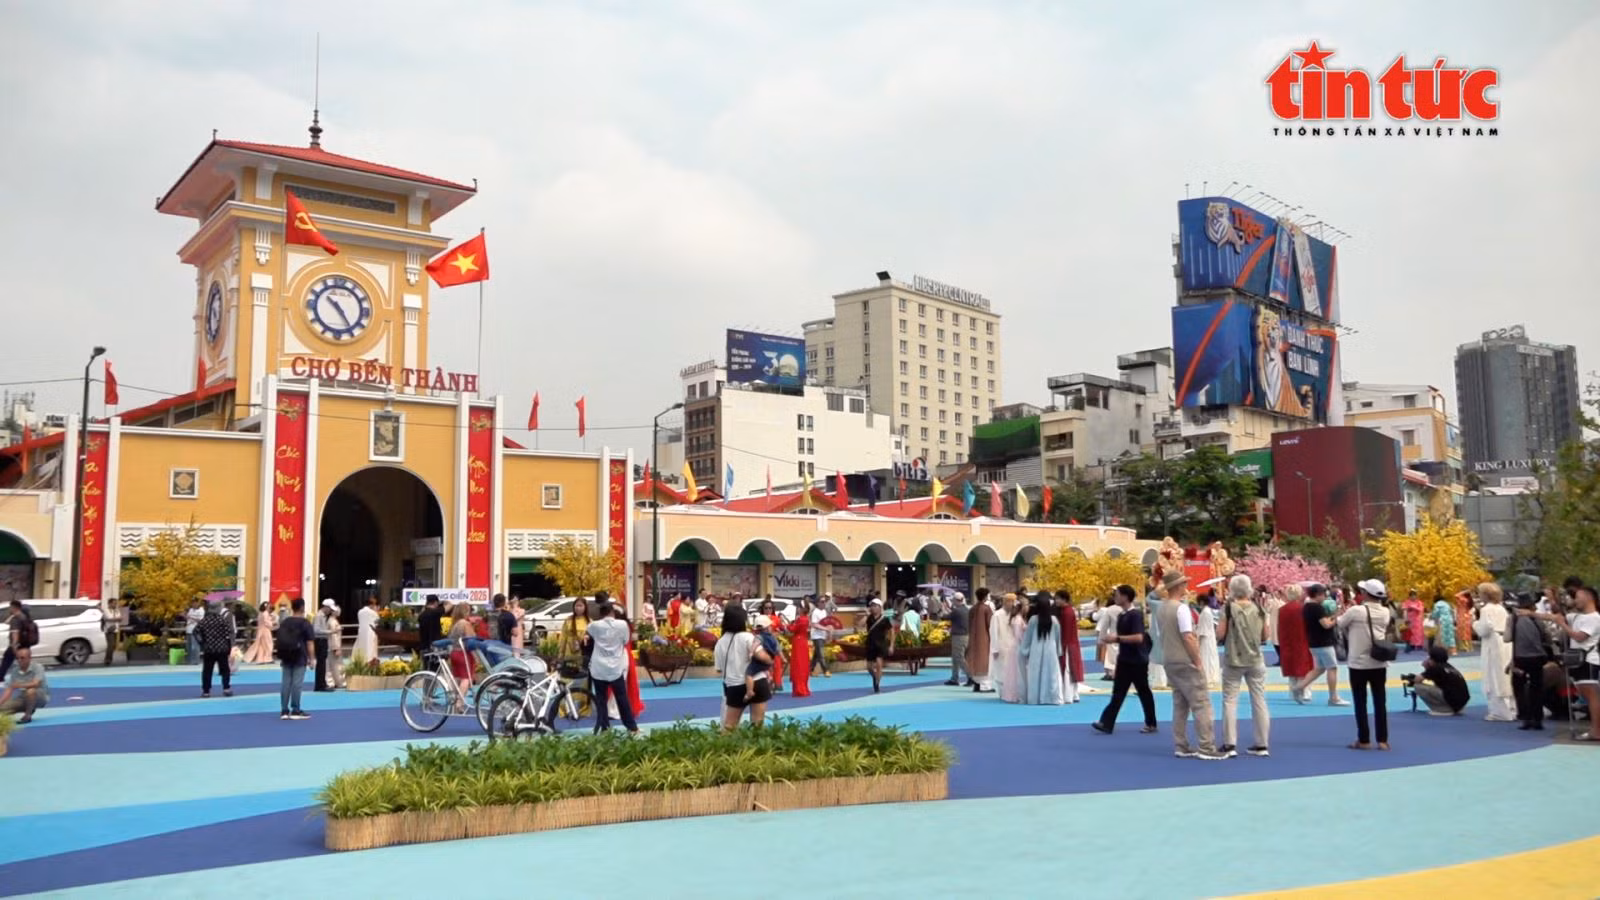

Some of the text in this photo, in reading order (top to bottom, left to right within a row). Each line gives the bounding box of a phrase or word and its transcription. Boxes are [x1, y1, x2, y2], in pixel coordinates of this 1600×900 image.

[291, 356, 479, 392] CHỢ BẾN THÀNH
[1474, 460, 1502, 471] KING
[774, 569, 800, 588] Vikki
[469, 590, 487, 601] 2026
